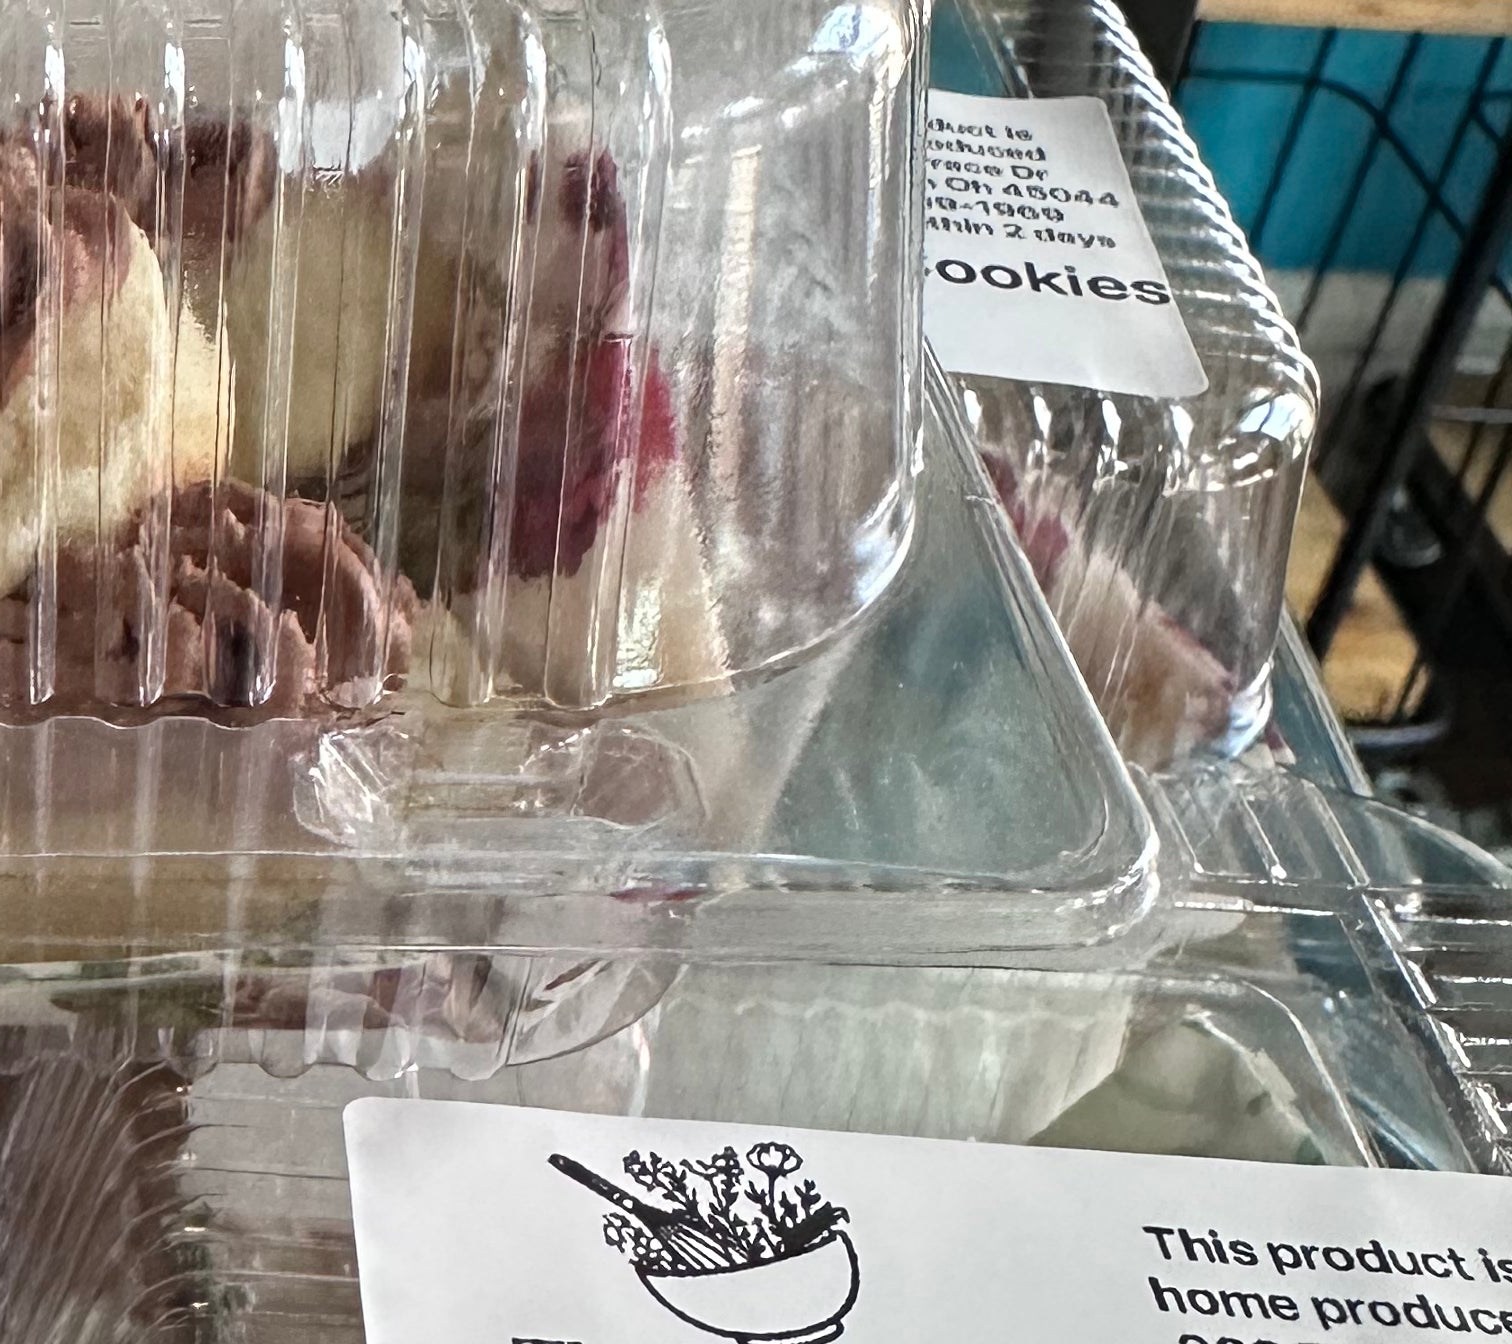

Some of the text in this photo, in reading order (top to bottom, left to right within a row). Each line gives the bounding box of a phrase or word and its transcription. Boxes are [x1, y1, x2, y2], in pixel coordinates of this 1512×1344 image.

[924, 258, 1171, 306] ookies
[1142, 1226, 1259, 1266] This
[1266, 1239, 1475, 1281] product
[1148, 1276, 1300, 1322] home
